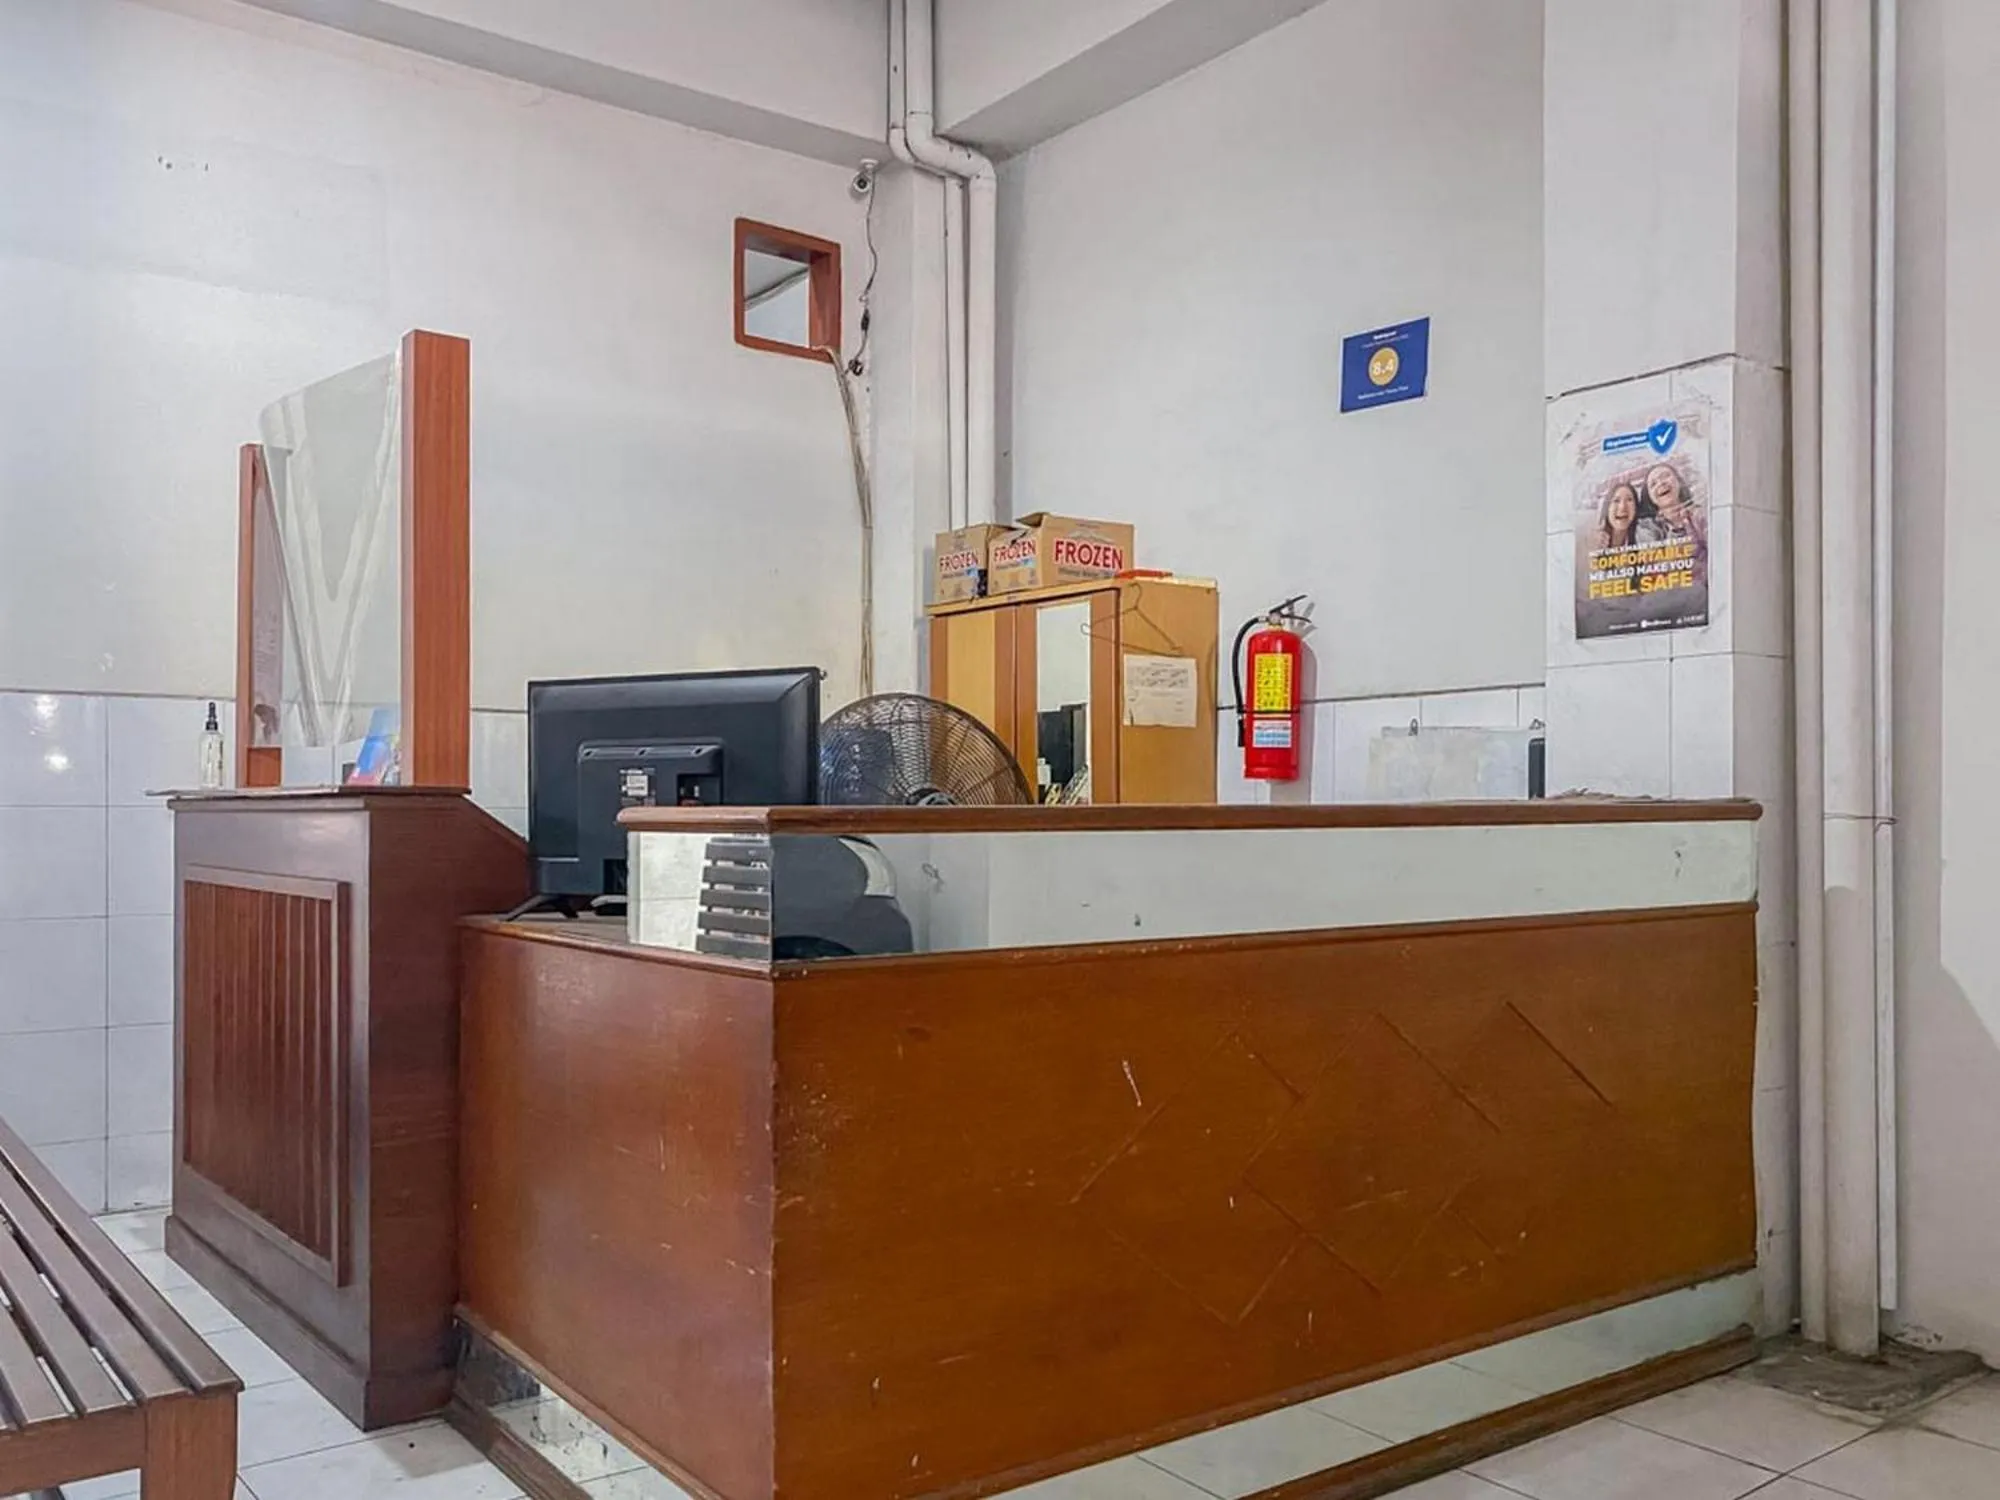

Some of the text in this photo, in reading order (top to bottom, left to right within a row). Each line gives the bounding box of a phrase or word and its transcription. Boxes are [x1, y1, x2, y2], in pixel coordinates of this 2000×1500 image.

[1372, 359, 1394, 376] 8.4
[940, 552, 979, 570] FROZEN
[994, 540, 1037, 562] FROZEN
[1055, 540, 1123, 569] FROZEN
[1590, 544, 1694, 570] COMFORTABLE
[1607, 567, 1635, 579] ALSO
[1637, 563, 1668, 575] MAKE
[1670, 558, 1694, 570] YOU
[1589, 570, 1693, 599] FEEL SAFE
